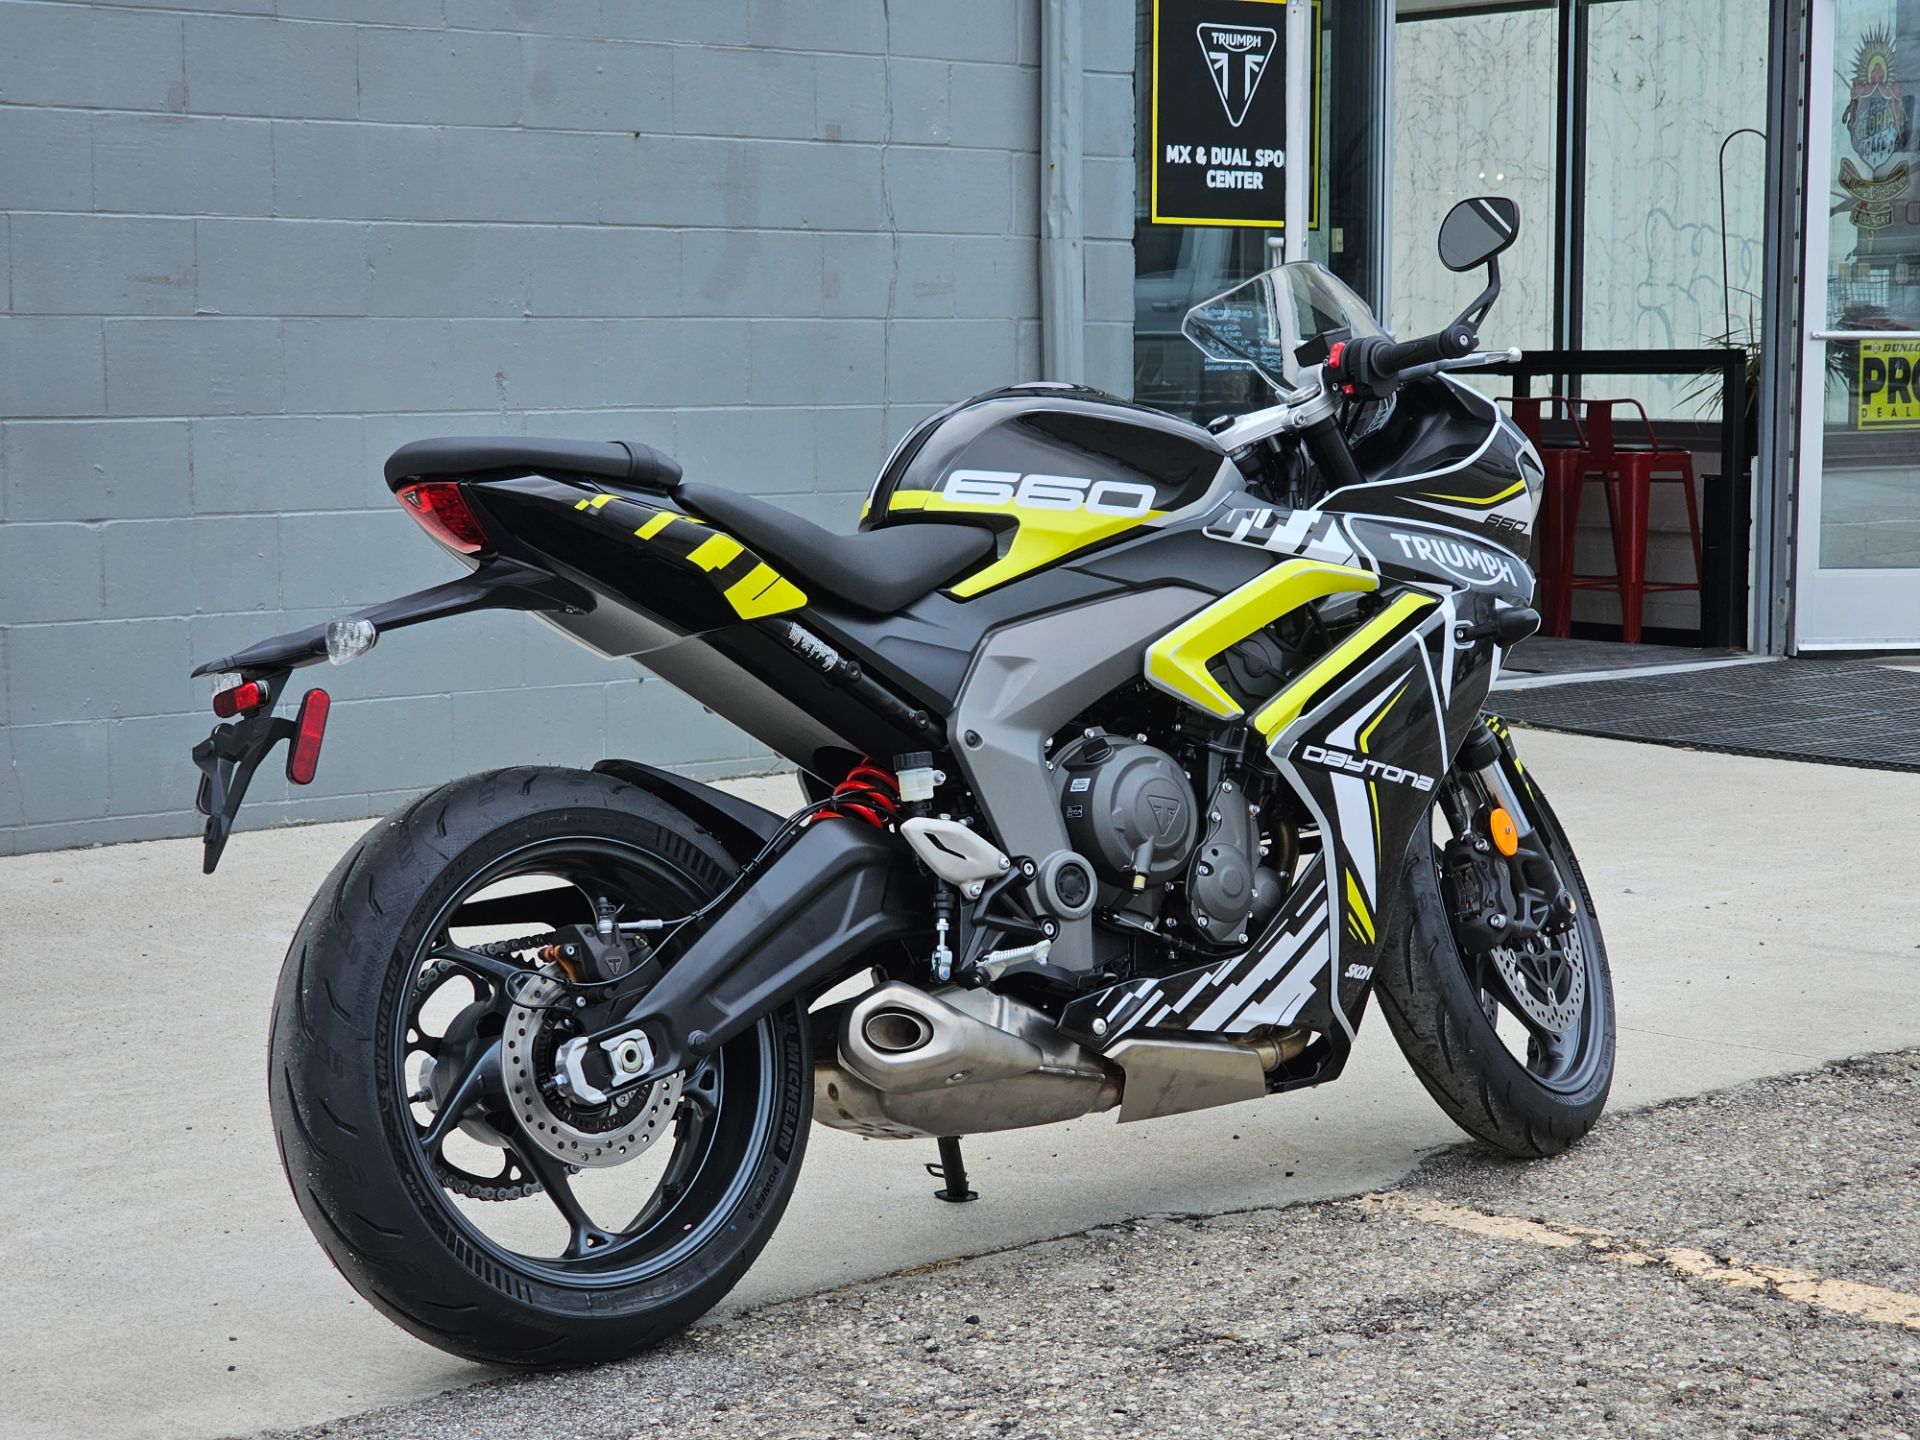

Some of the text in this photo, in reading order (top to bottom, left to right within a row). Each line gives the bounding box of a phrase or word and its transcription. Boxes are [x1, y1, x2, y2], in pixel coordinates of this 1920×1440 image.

[1211, 32, 1261, 50] TRIUMPH
[1165, 145, 1285, 168] MX & DUAL SPO
[1206, 169, 1264, 190] CENTER
[1861, 406, 1920, 418] DEAL
[942, 469, 1157, 518] 660
[1390, 533, 1518, 586] TRIUMPH
[1302, 745, 1436, 792] DAYTONA
[376, 960, 400, 1081] MICHELIN
[778, 1042, 800, 1153] MICHELIN
[755, 1165, 780, 1213] POWER
